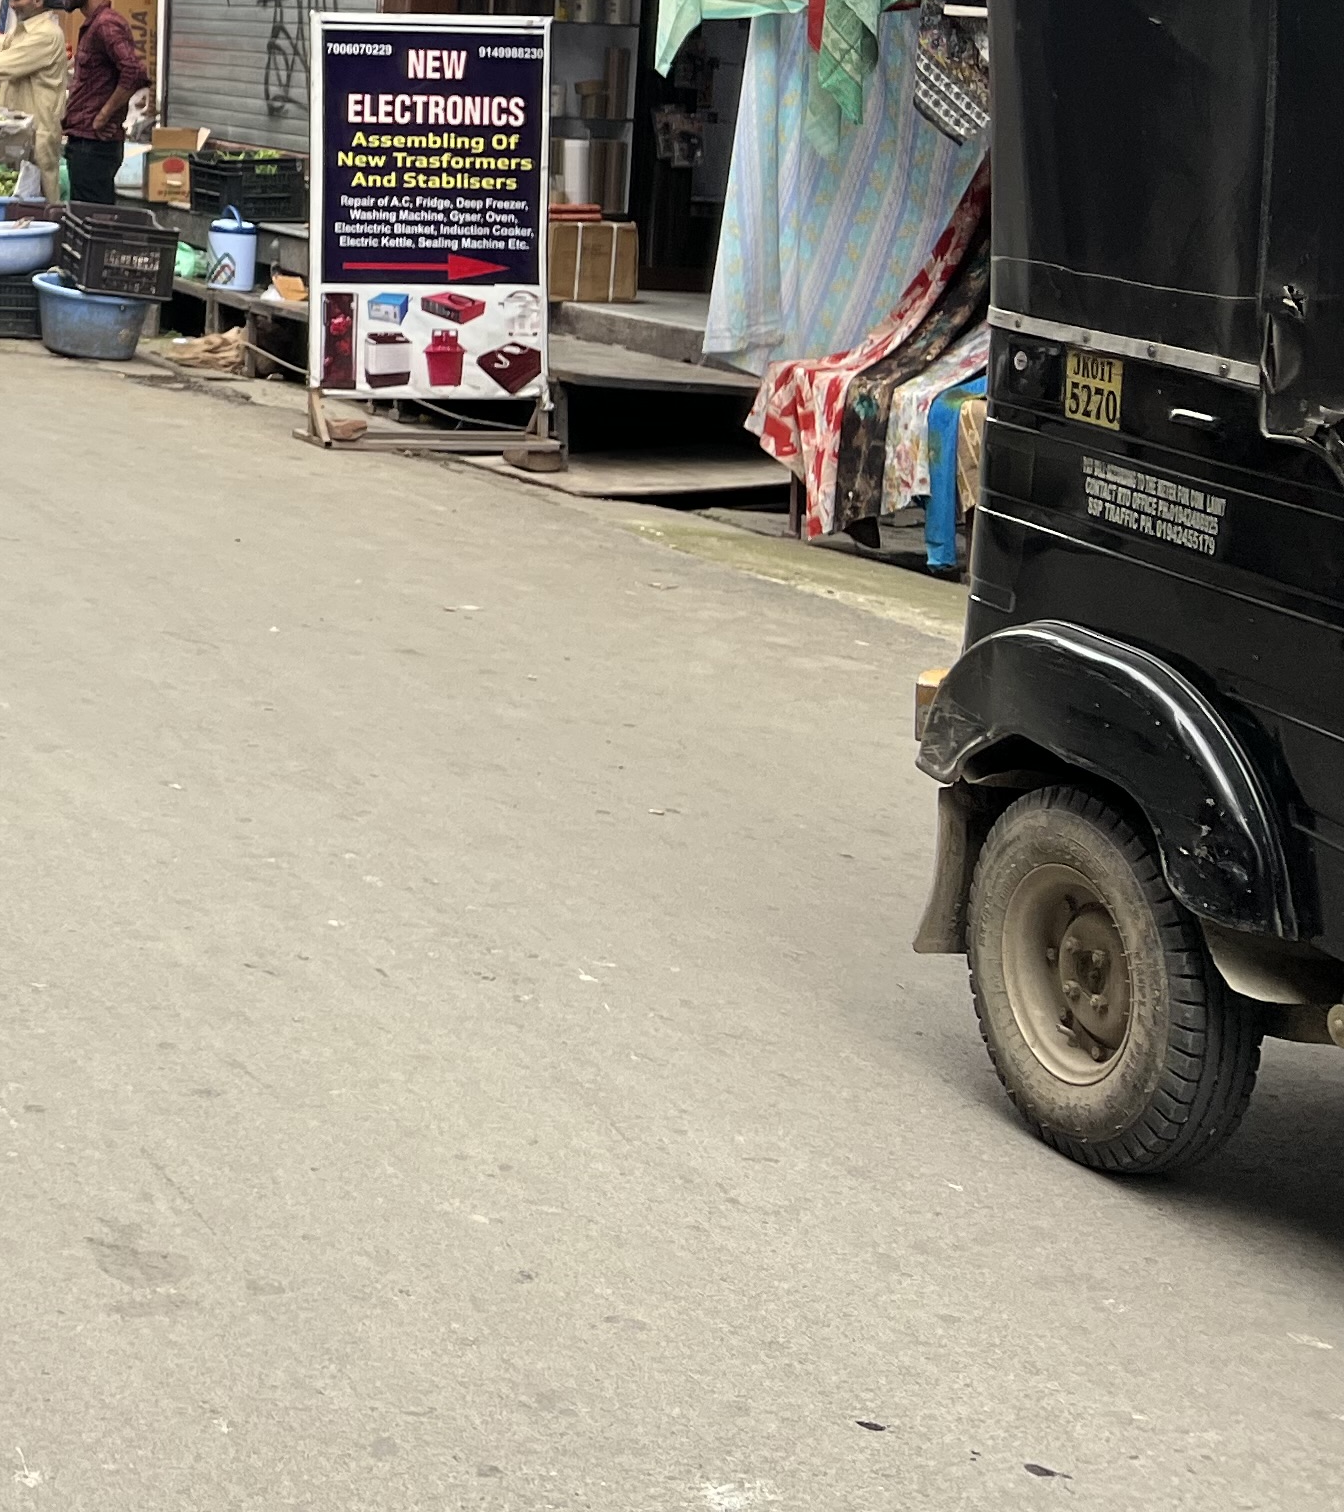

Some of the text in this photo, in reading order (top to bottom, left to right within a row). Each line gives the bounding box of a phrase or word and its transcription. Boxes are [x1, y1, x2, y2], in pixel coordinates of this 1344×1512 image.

[407, 48, 468, 80] NEW
[347, 93, 526, 127] ELECTRONICS
[351, 131, 520, 154] Assembling Of
[337, 150, 534, 171] New Trasformers
[351, 171, 518, 191] And Stablisers
[340, 194, 375, 208] Repair
[377, 195, 389, 207] of
[415, 196, 454, 211] Fridge,
[456, 197, 483, 211] Deep
[485, 197, 529, 212] Freezer,
[349, 208, 397, 223] Washing
[399, 209, 448, 224] Machine,
[485, 211, 519, 225] Oven,
[393, 223, 438, 236] Blanket,
[440, 223, 491, 236] Induction
[492, 224, 535, 238] Cooker,
[339, 235, 380, 248] Electric
[418, 237, 459, 251] Sealing
[461, 237, 506, 250] Machine
[1068, 380, 1118, 425] 5270
[1104, 501, 1140, 530] TRAFFIC
